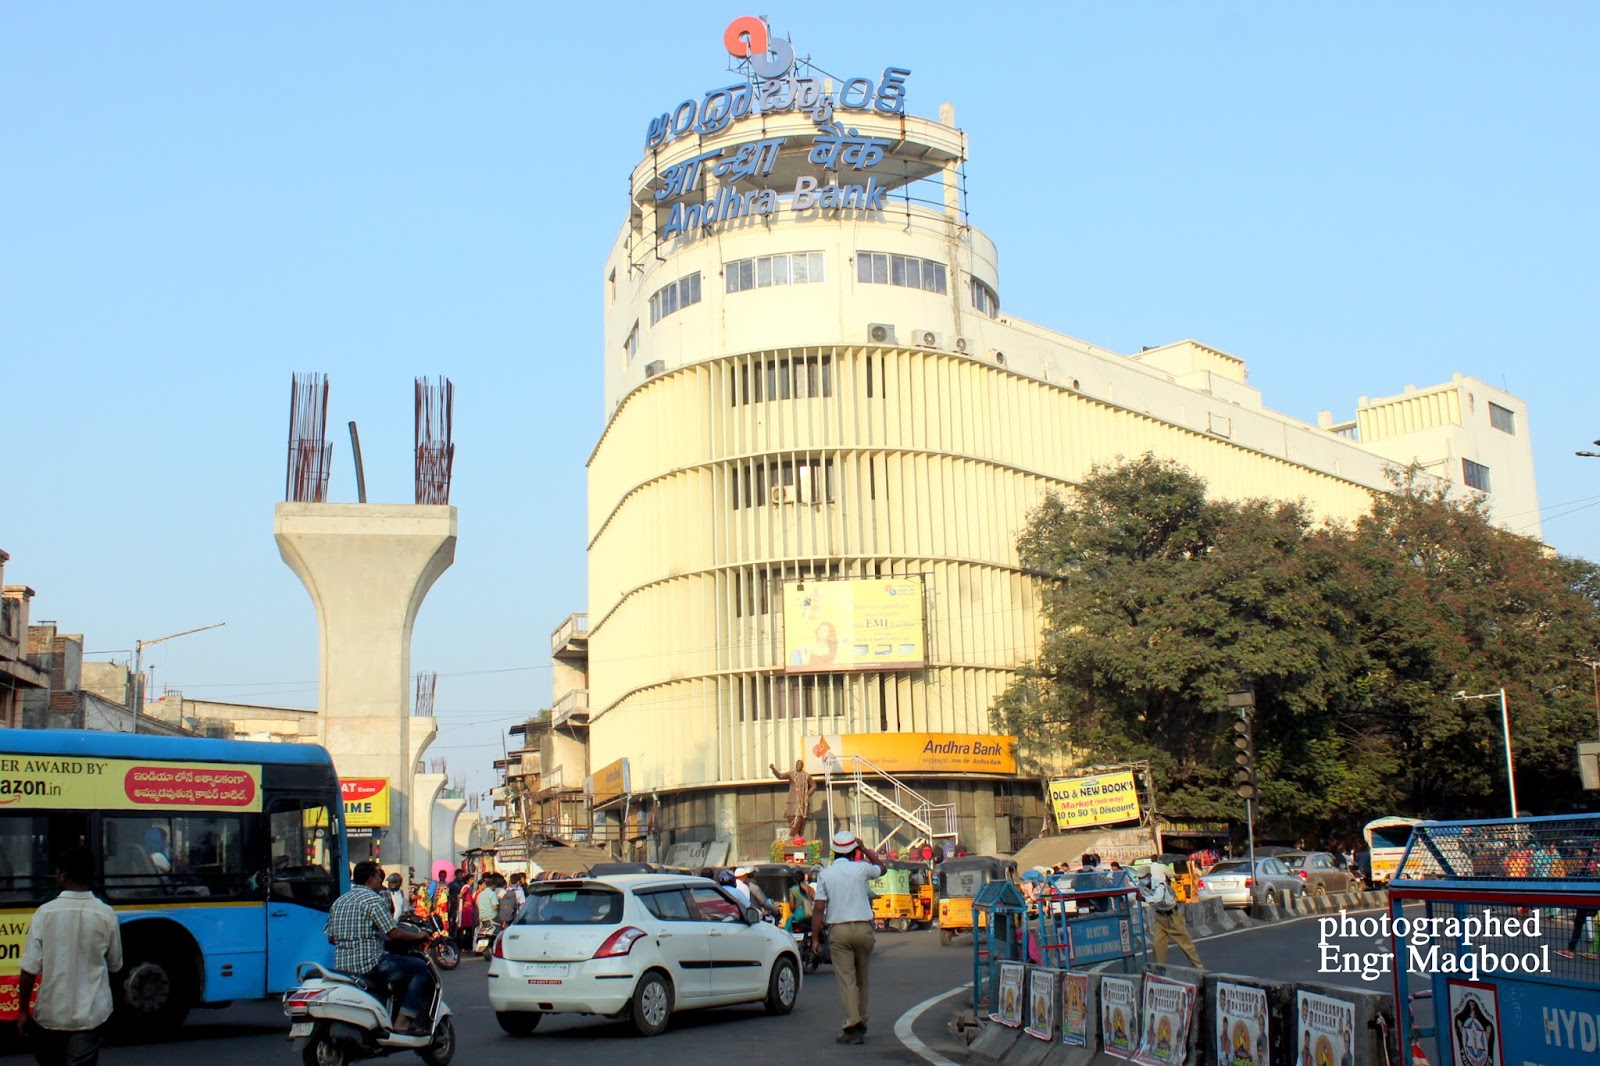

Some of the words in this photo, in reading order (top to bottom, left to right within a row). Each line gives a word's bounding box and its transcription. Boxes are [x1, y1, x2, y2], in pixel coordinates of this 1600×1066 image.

[808, 121, 892, 170] बैंक
[662, 186, 778, 241] Andhra
[791, 176, 888, 211] Bank
[865, 619, 888, 629] EMI
[923, 740, 970, 754] Andhra
[973, 741, 1002, 756] Bank
[1, 760, 20, 772] ER
[24, 760, 83, 775] AWARD
[340, 783, 357, 793] AT
[1053, 790, 1070, 800] OLD
[1072, 789, 1078, 799] &
[1080, 785, 1100, 797] NEW
[1101, 780, 1134, 794] BOOK'S
[1058, 811, 1066, 820] 10
[1067, 810, 1076, 819] to
[1077, 807, 1088, 817] 50
[1099, 802, 1135, 815] Discount
[1061, 799, 1094, 811] Market
